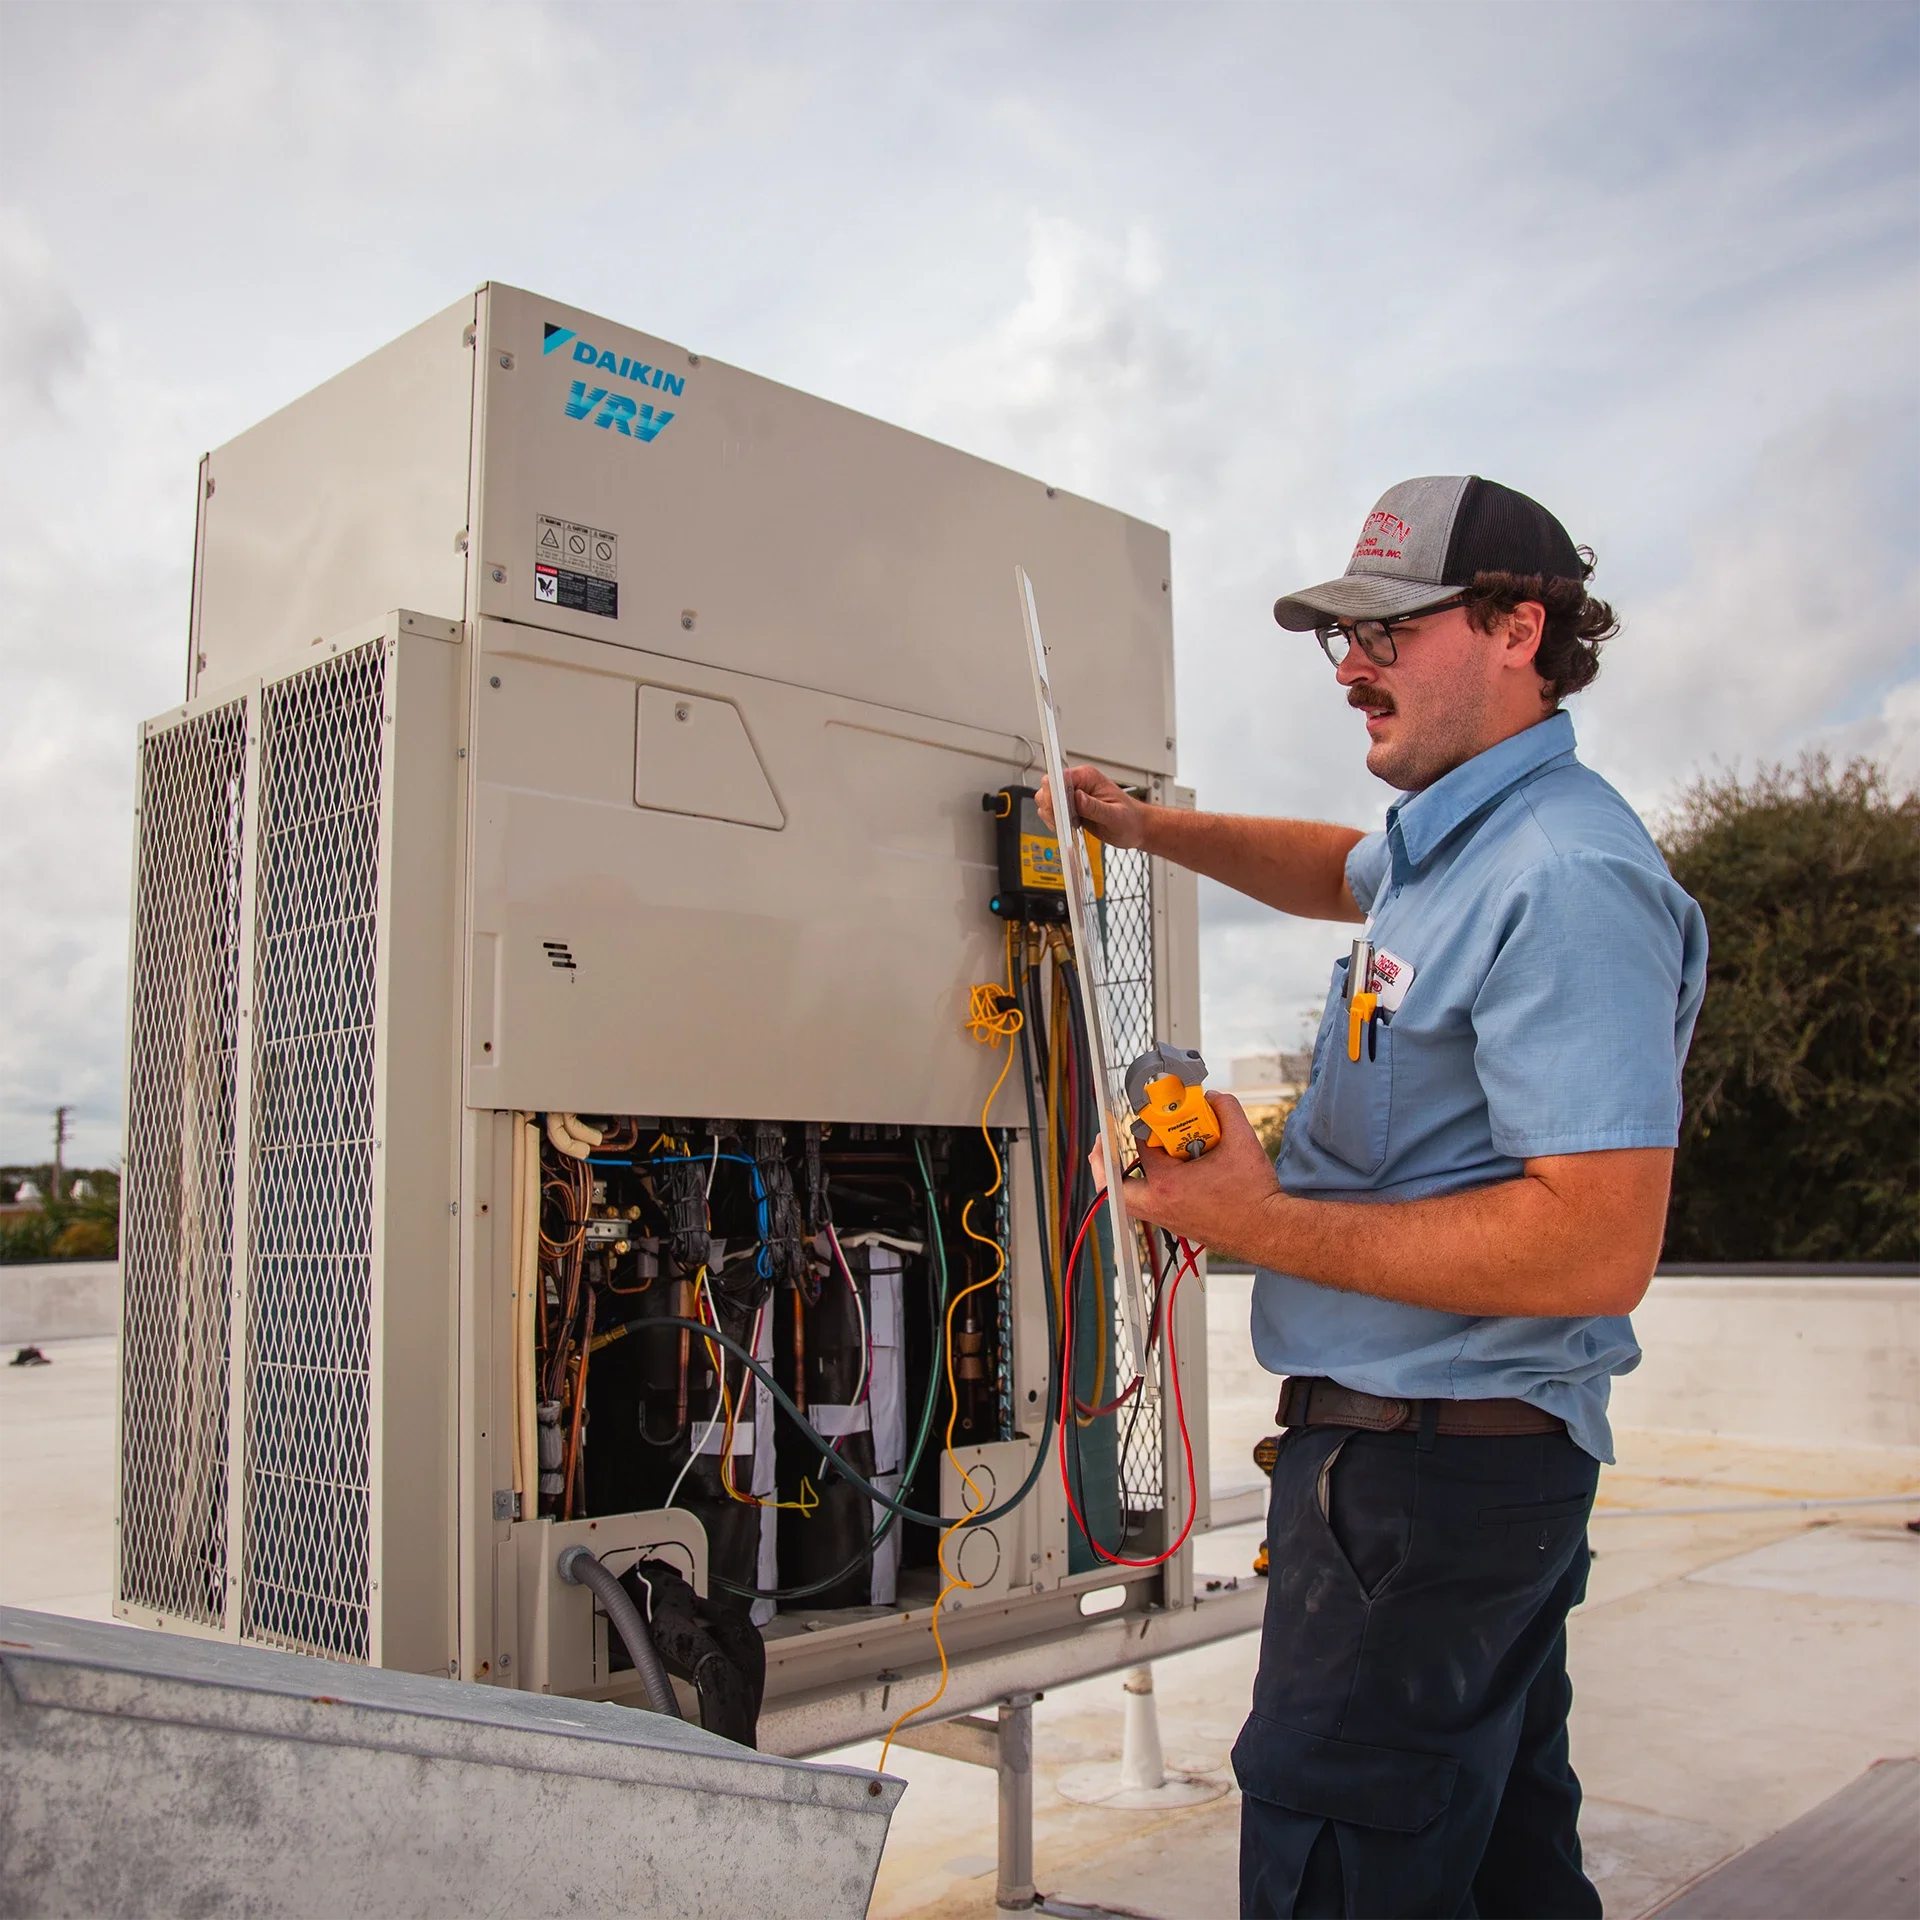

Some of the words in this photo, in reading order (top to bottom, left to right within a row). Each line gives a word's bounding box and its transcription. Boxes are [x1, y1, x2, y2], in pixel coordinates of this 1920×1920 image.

[572, 341, 686, 397] DAIKIN
[564, 380, 676, 443] VRV
[1386, 550, 1402, 559] INC.
[1167, 1116, 1199, 1132] Fieldpiece
